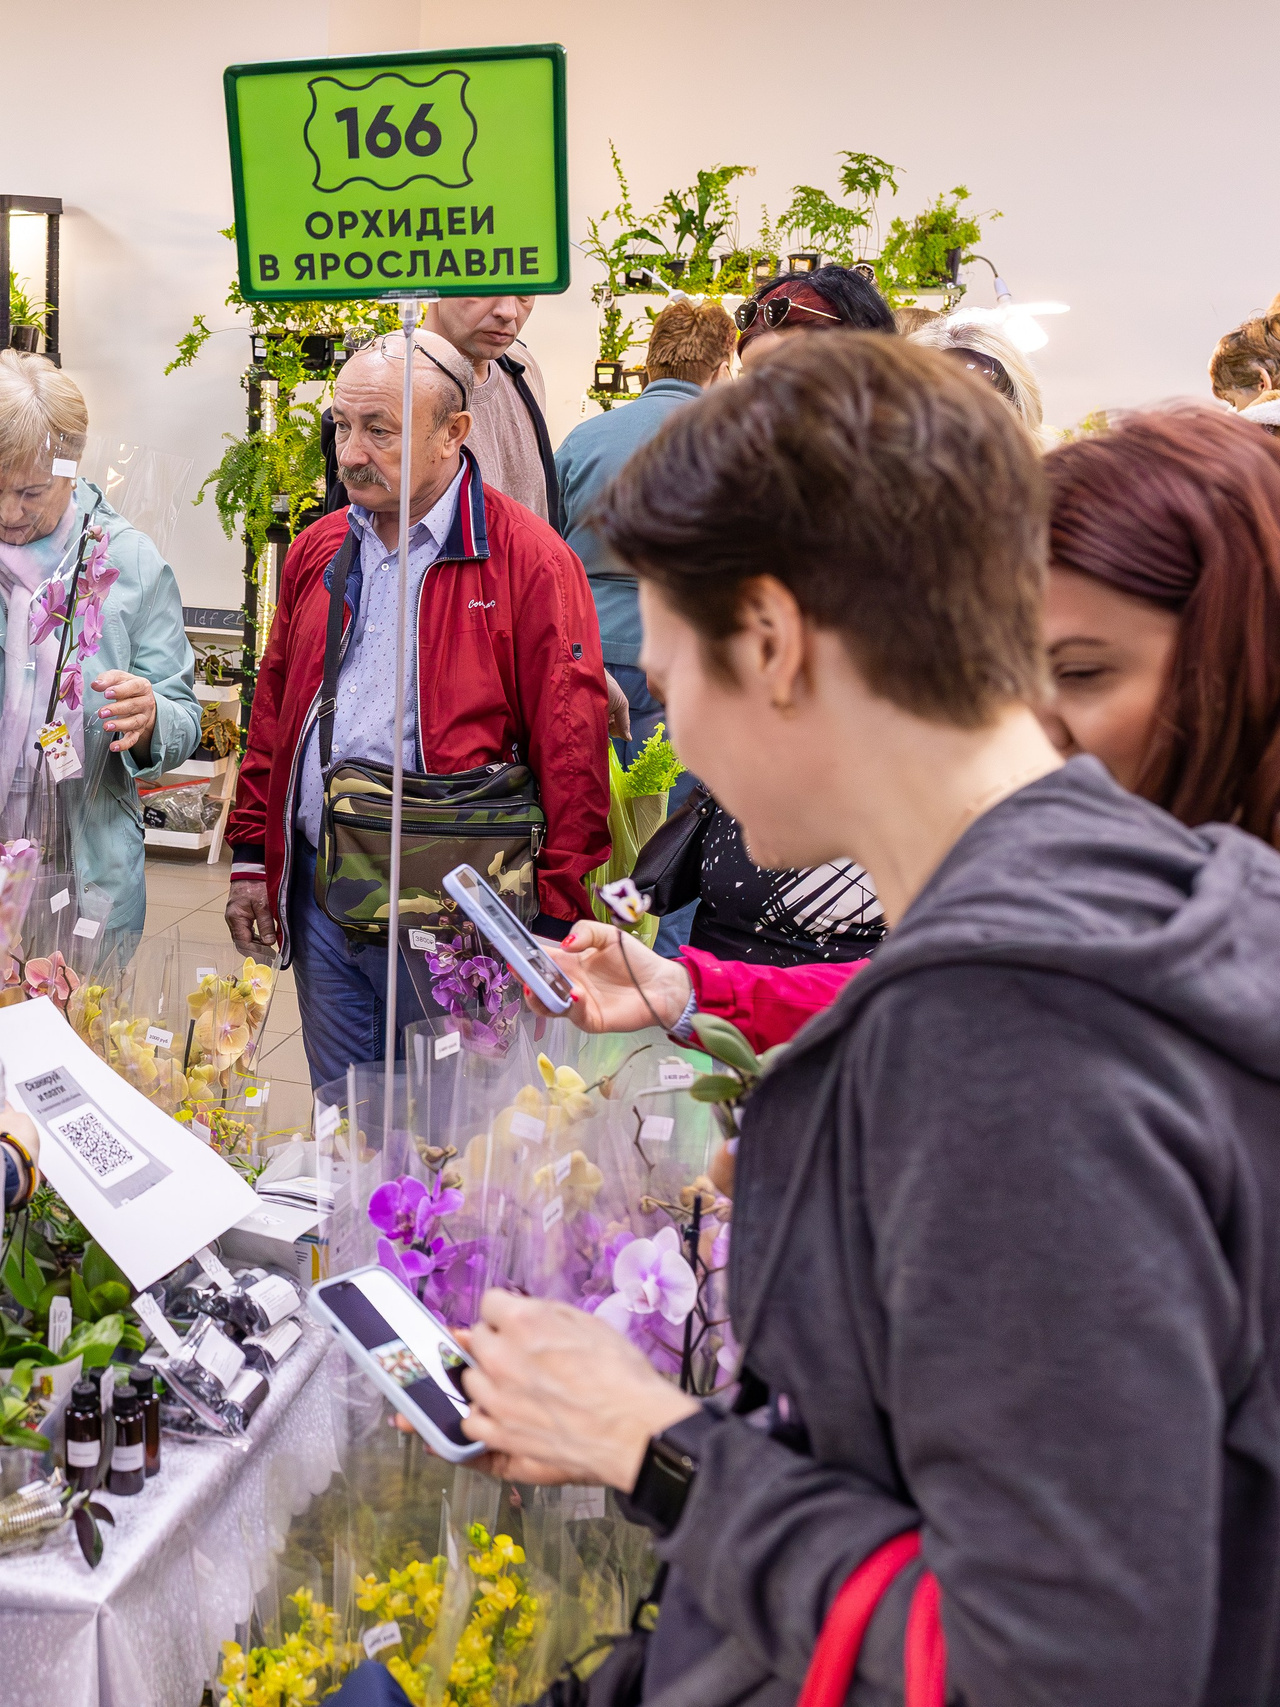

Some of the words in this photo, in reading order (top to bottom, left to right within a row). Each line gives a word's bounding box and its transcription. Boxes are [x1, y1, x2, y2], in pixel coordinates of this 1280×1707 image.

[335, 103, 442, 159] 166
[305, 205, 494, 241] ОРХИДЕИ
[259, 254, 280, 281] В
[294, 246, 539, 280] ЯРОСЛАВЛЕ
